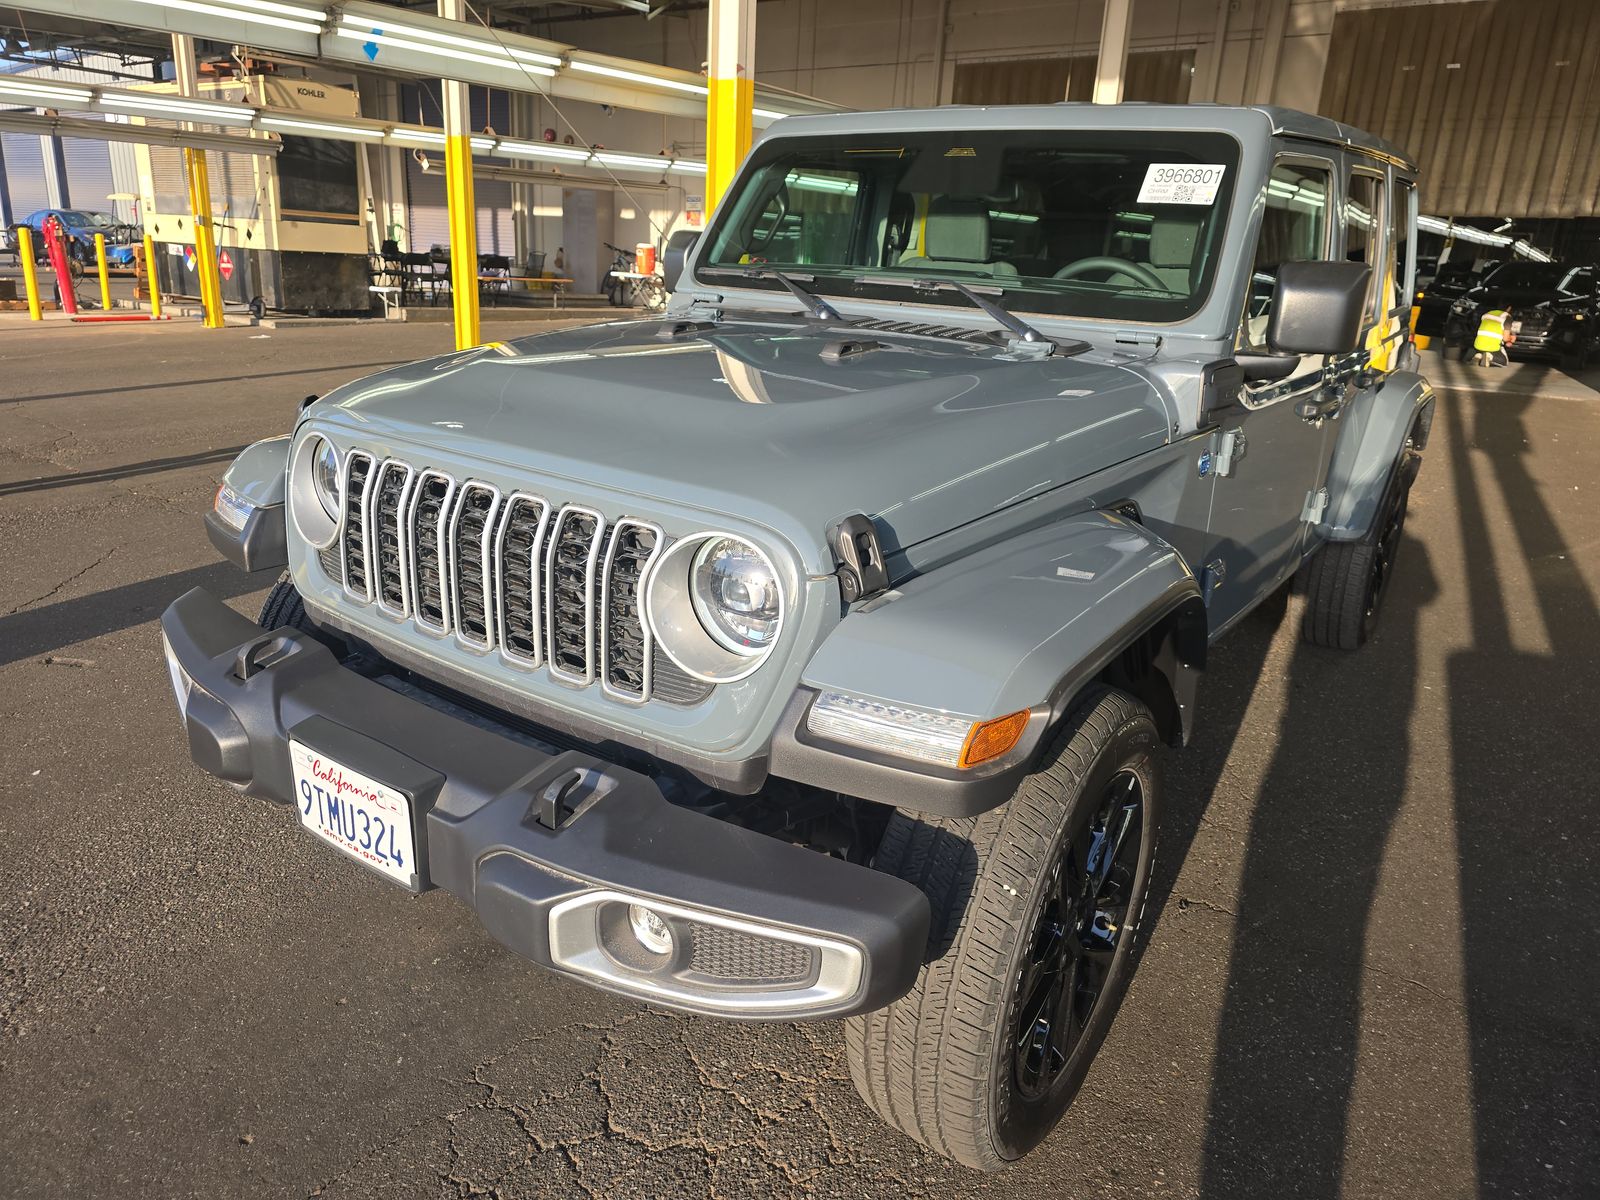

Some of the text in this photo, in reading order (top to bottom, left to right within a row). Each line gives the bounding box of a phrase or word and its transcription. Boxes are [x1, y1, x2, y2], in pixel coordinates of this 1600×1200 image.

[297, 87, 326, 98] KOHLER
[1154, 168, 1222, 184] 3966801
[313, 759, 386, 810] California
[301, 779, 404, 868] 9TMU324
[323, 827, 383, 864] dmv.ca.gov
